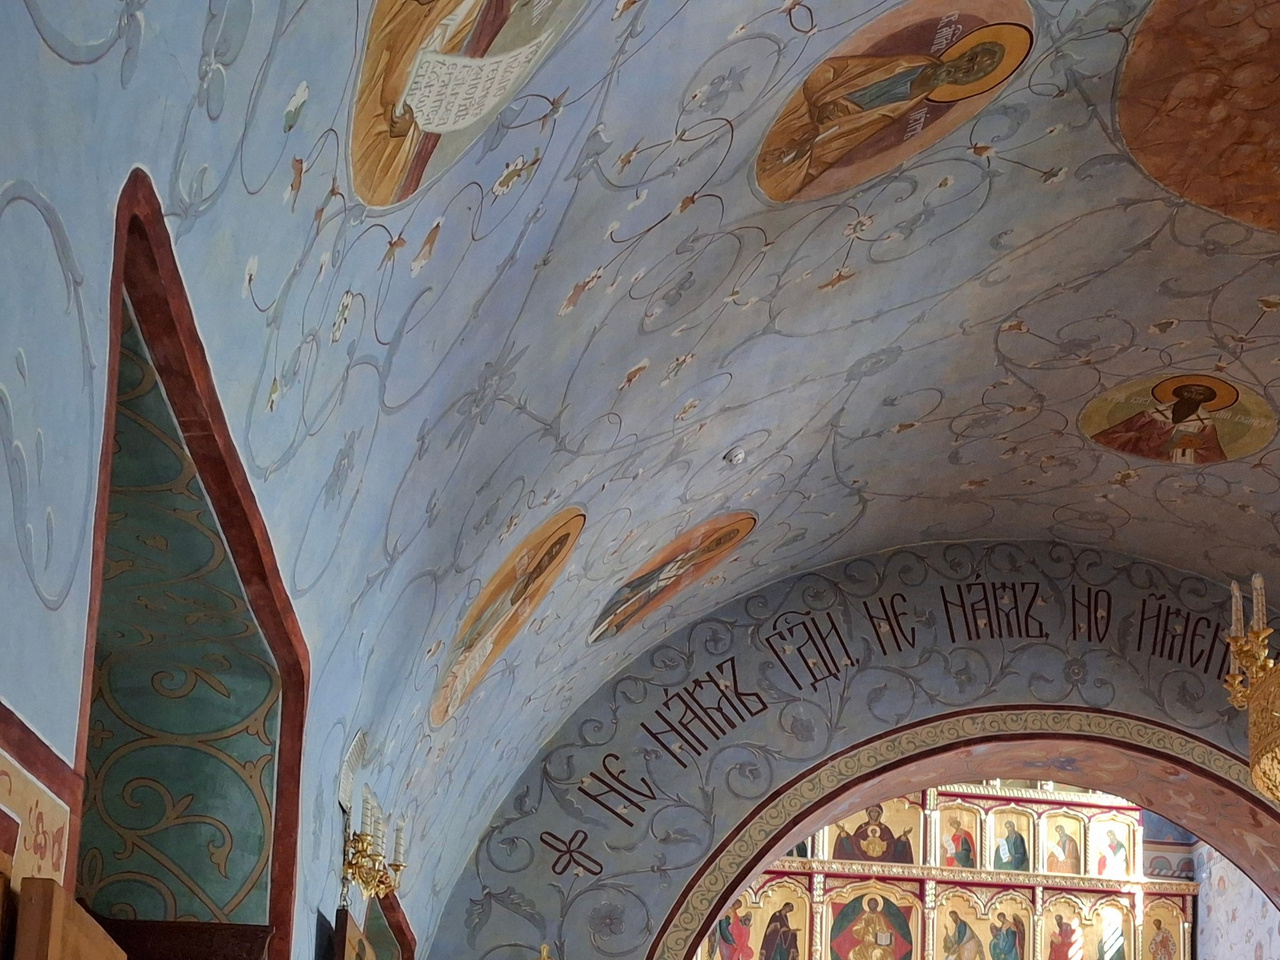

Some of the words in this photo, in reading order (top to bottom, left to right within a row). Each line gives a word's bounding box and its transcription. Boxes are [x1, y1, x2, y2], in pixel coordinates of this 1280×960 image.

[577, 753, 656, 828] НЕ
[862, 593, 916, 656] НЕ
[1071, 584, 1112, 643] НО
